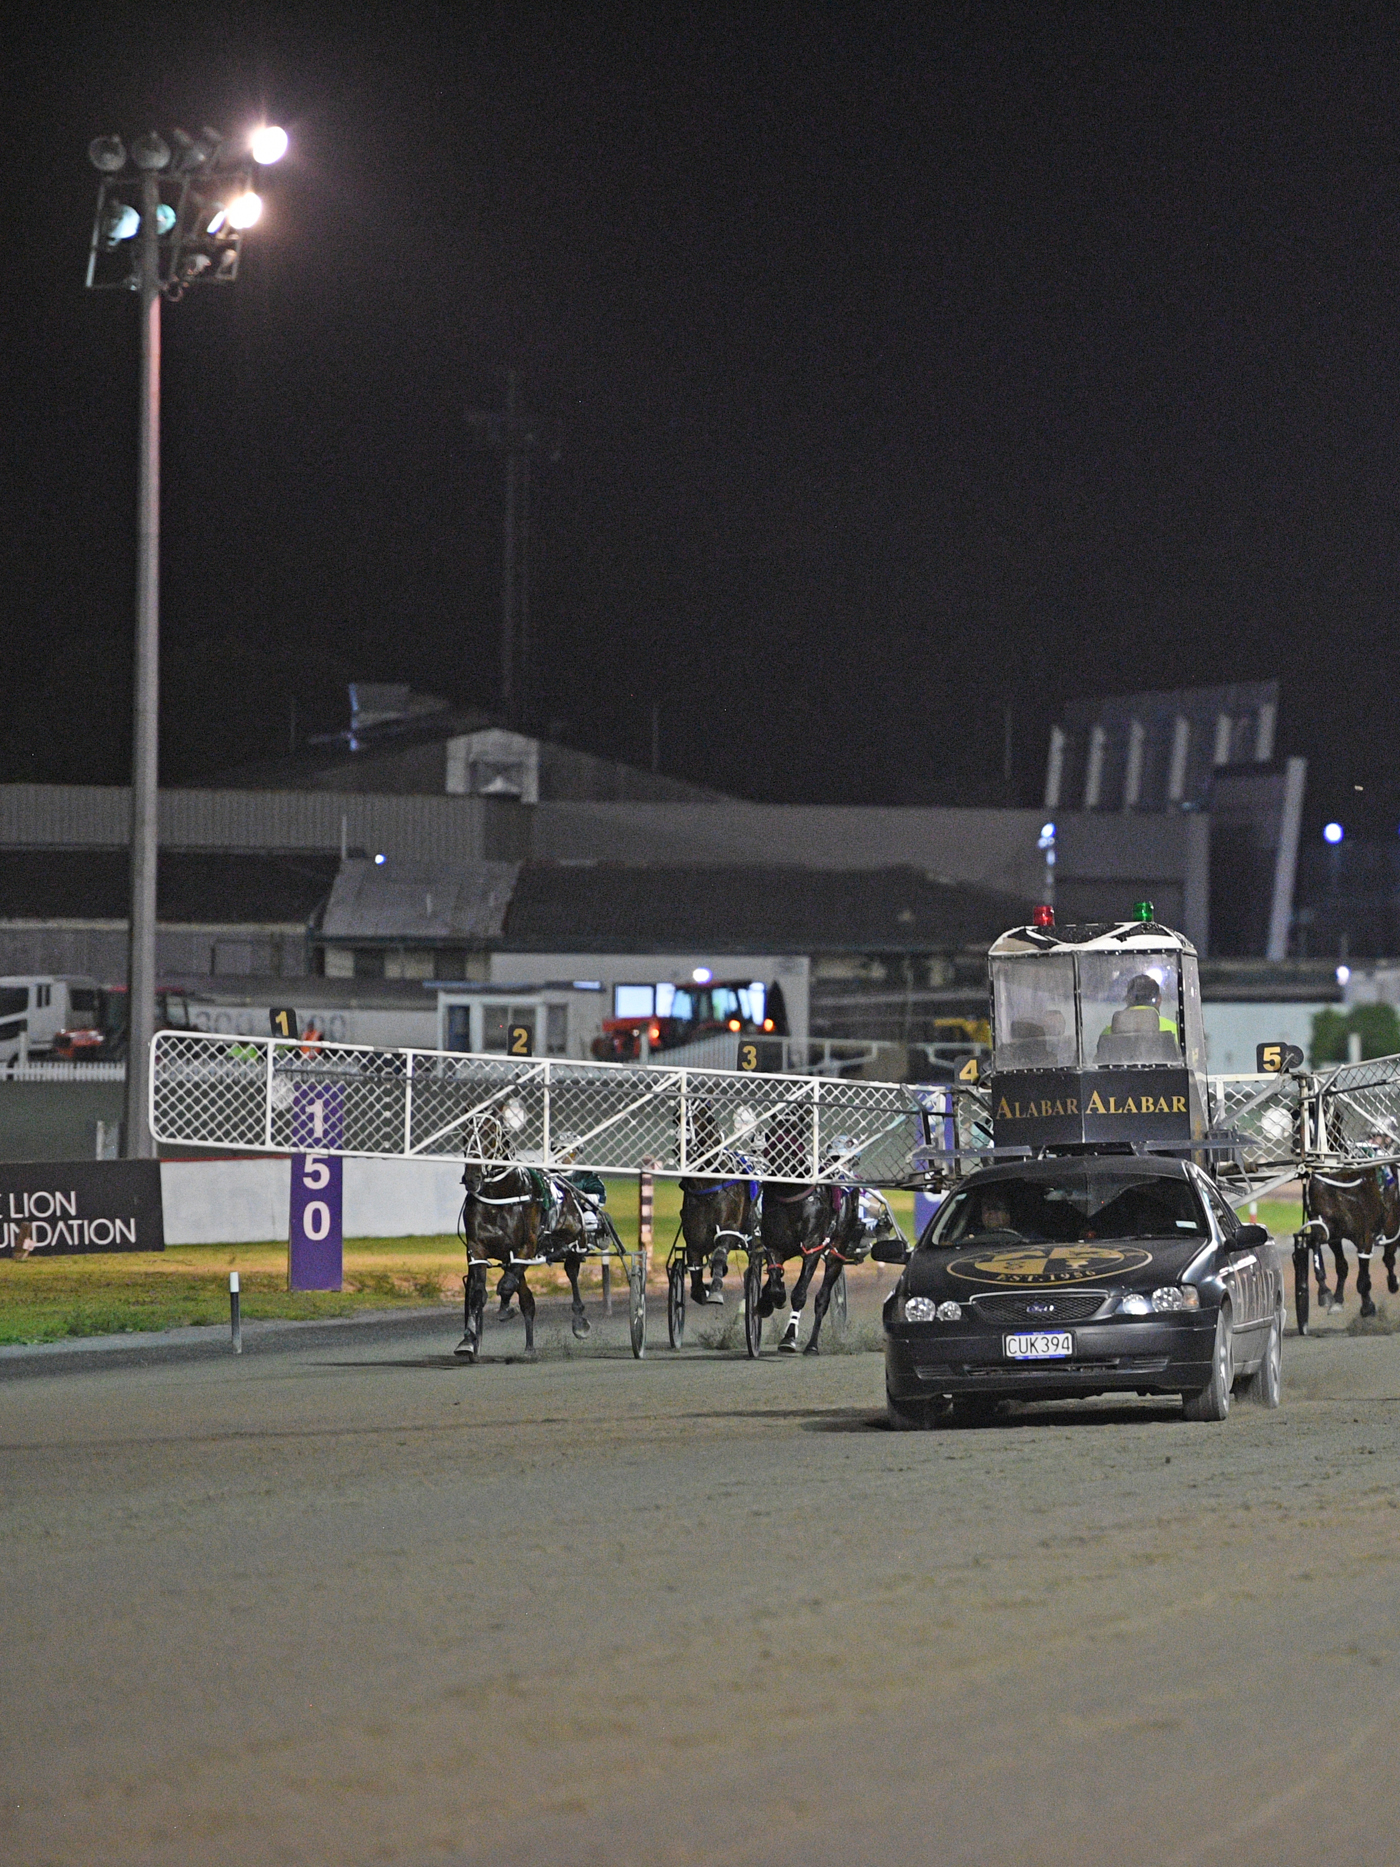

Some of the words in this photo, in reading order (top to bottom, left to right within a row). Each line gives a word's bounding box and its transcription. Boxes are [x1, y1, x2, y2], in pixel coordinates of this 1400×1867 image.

[275, 1010, 290, 1036] 1
[512, 1028, 528, 1054] 2
[741, 1045, 758, 1071] 3
[959, 1059, 979, 1083] 4
[1262, 1046, 1282, 1072] 5
[995, 1096, 1079, 1120] ALABAR
[1085, 1090, 1188, 1115] ALABAR
[302, 1099, 331, 1241] 150
[9, 1191, 77, 1218] LION
[1007, 1335, 1071, 1355] CUK394
